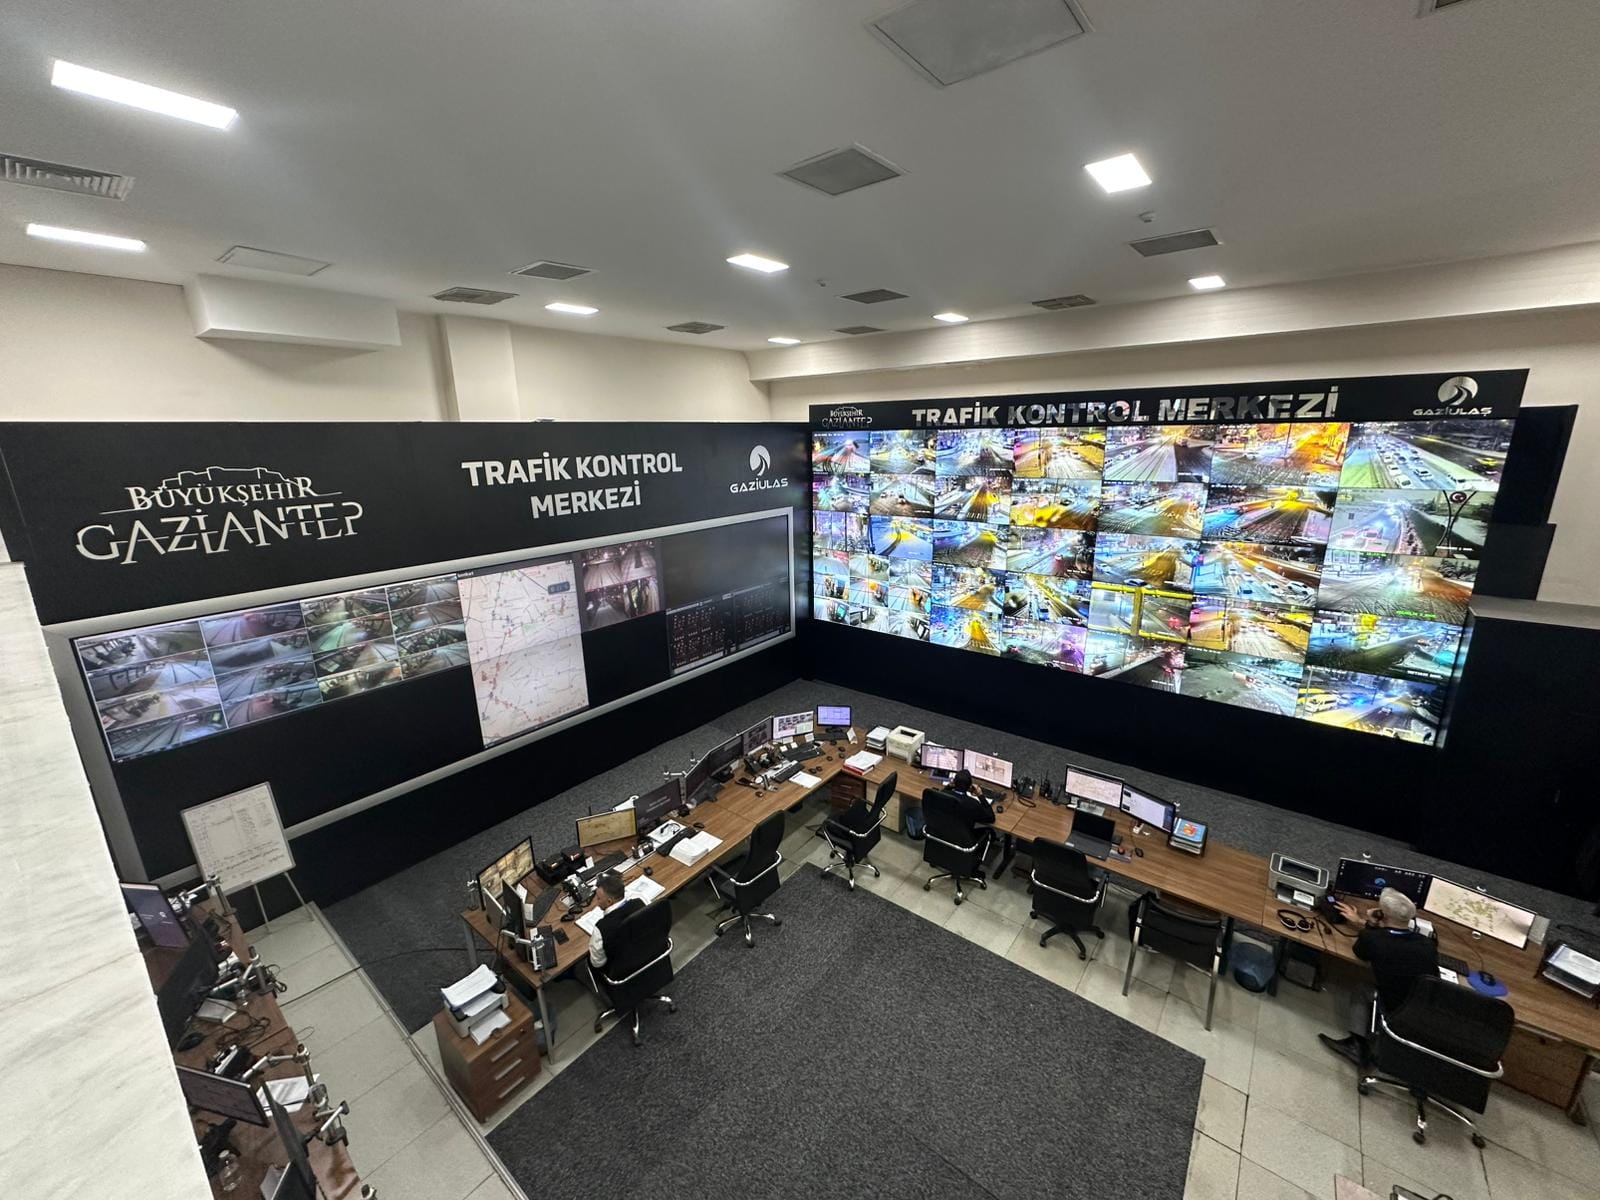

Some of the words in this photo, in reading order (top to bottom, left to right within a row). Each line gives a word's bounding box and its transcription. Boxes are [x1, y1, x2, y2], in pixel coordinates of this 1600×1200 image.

[912, 402, 999, 426] TRAFİK
[1008, 400, 1150, 425] KONTROL
[1157, 386, 1339, 421] MERKEZİ
[461, 452, 570, 487] TRAFİK
[576, 452, 683, 480] KONTROL
[530, 480, 641, 519] MERKEZİ
